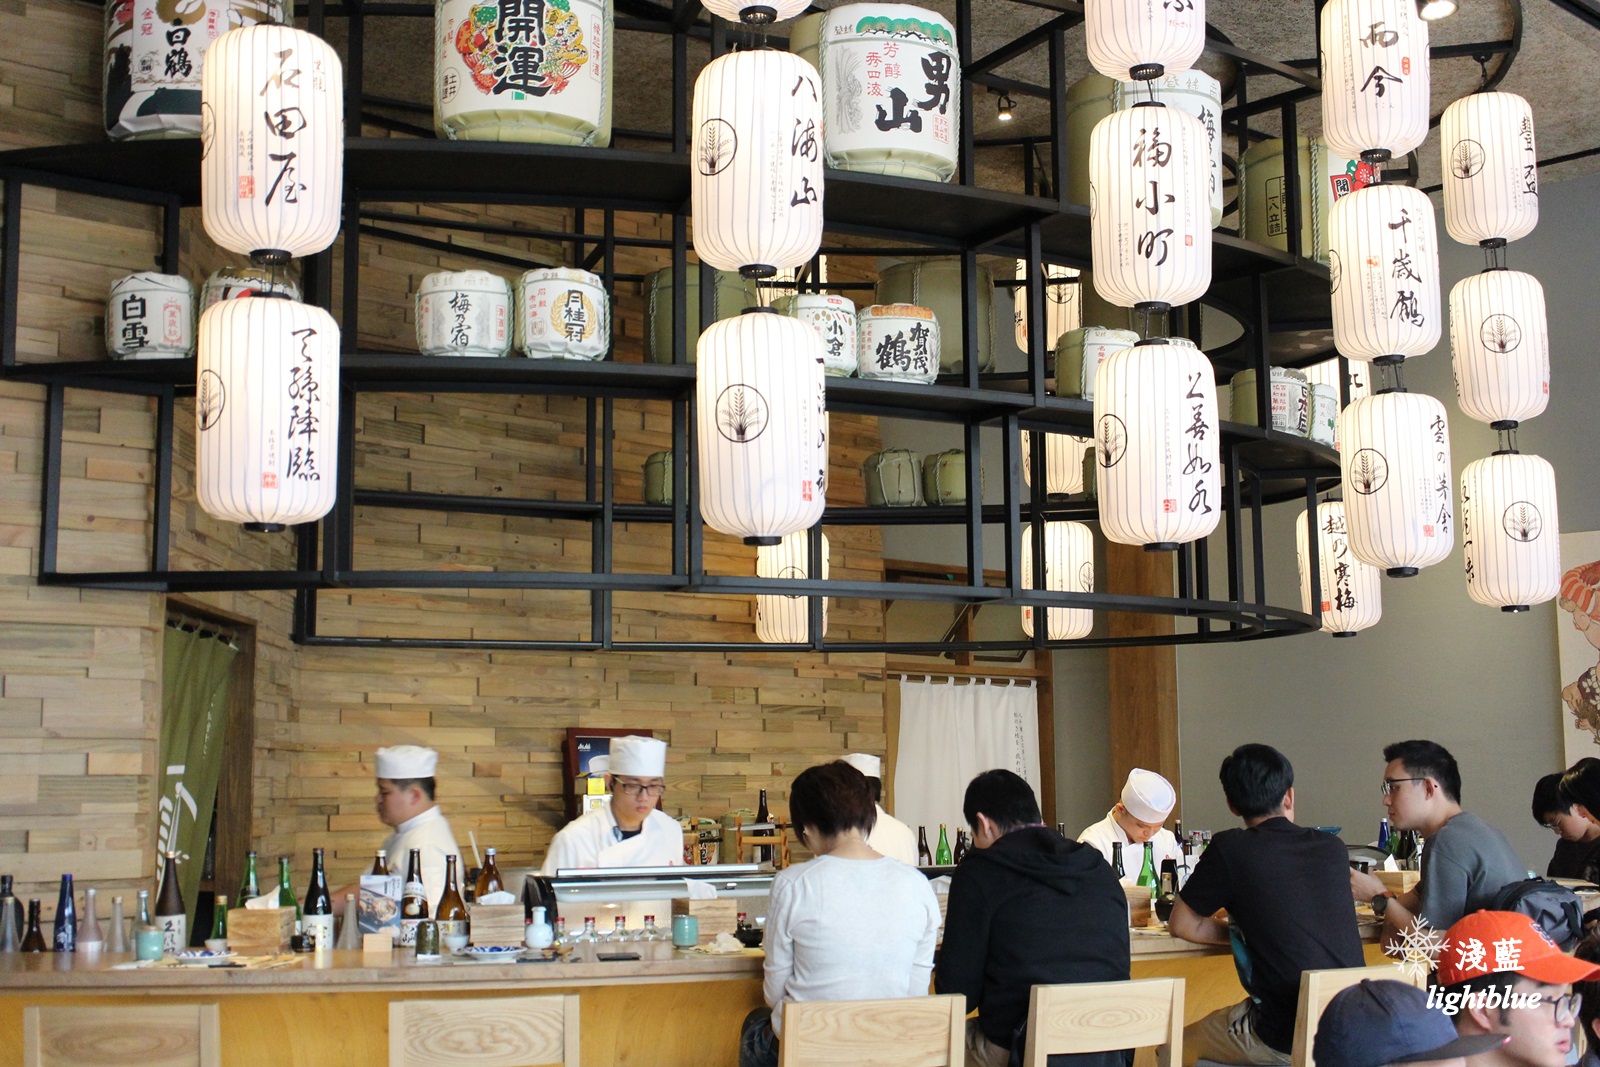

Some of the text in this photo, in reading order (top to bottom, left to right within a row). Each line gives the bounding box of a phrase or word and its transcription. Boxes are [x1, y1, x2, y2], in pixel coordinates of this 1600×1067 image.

[164, 17, 193, 78] 白鶴
[493, 0, 553, 97] 開運
[866, 41, 902, 97] 芳醇 秀四海
[874, 50, 952, 134] 男山
[259, 48, 308, 207] 石田屋
[790, 75, 818, 208] 八海山
[1132, 127, 1176, 267] 福小町
[563, 289, 587, 343] 月桂冠
[1387, 208, 1425, 328] 千歳鶴
[121, 293, 150, 349] 白雪
[448, 291, 473, 347] 梅乃宿
[286, 327, 321, 482] 天孫降臨
[1182, 371, 1213, 516] 上善如水
[1322, 514, 1357, 613] 越乃寒梅
